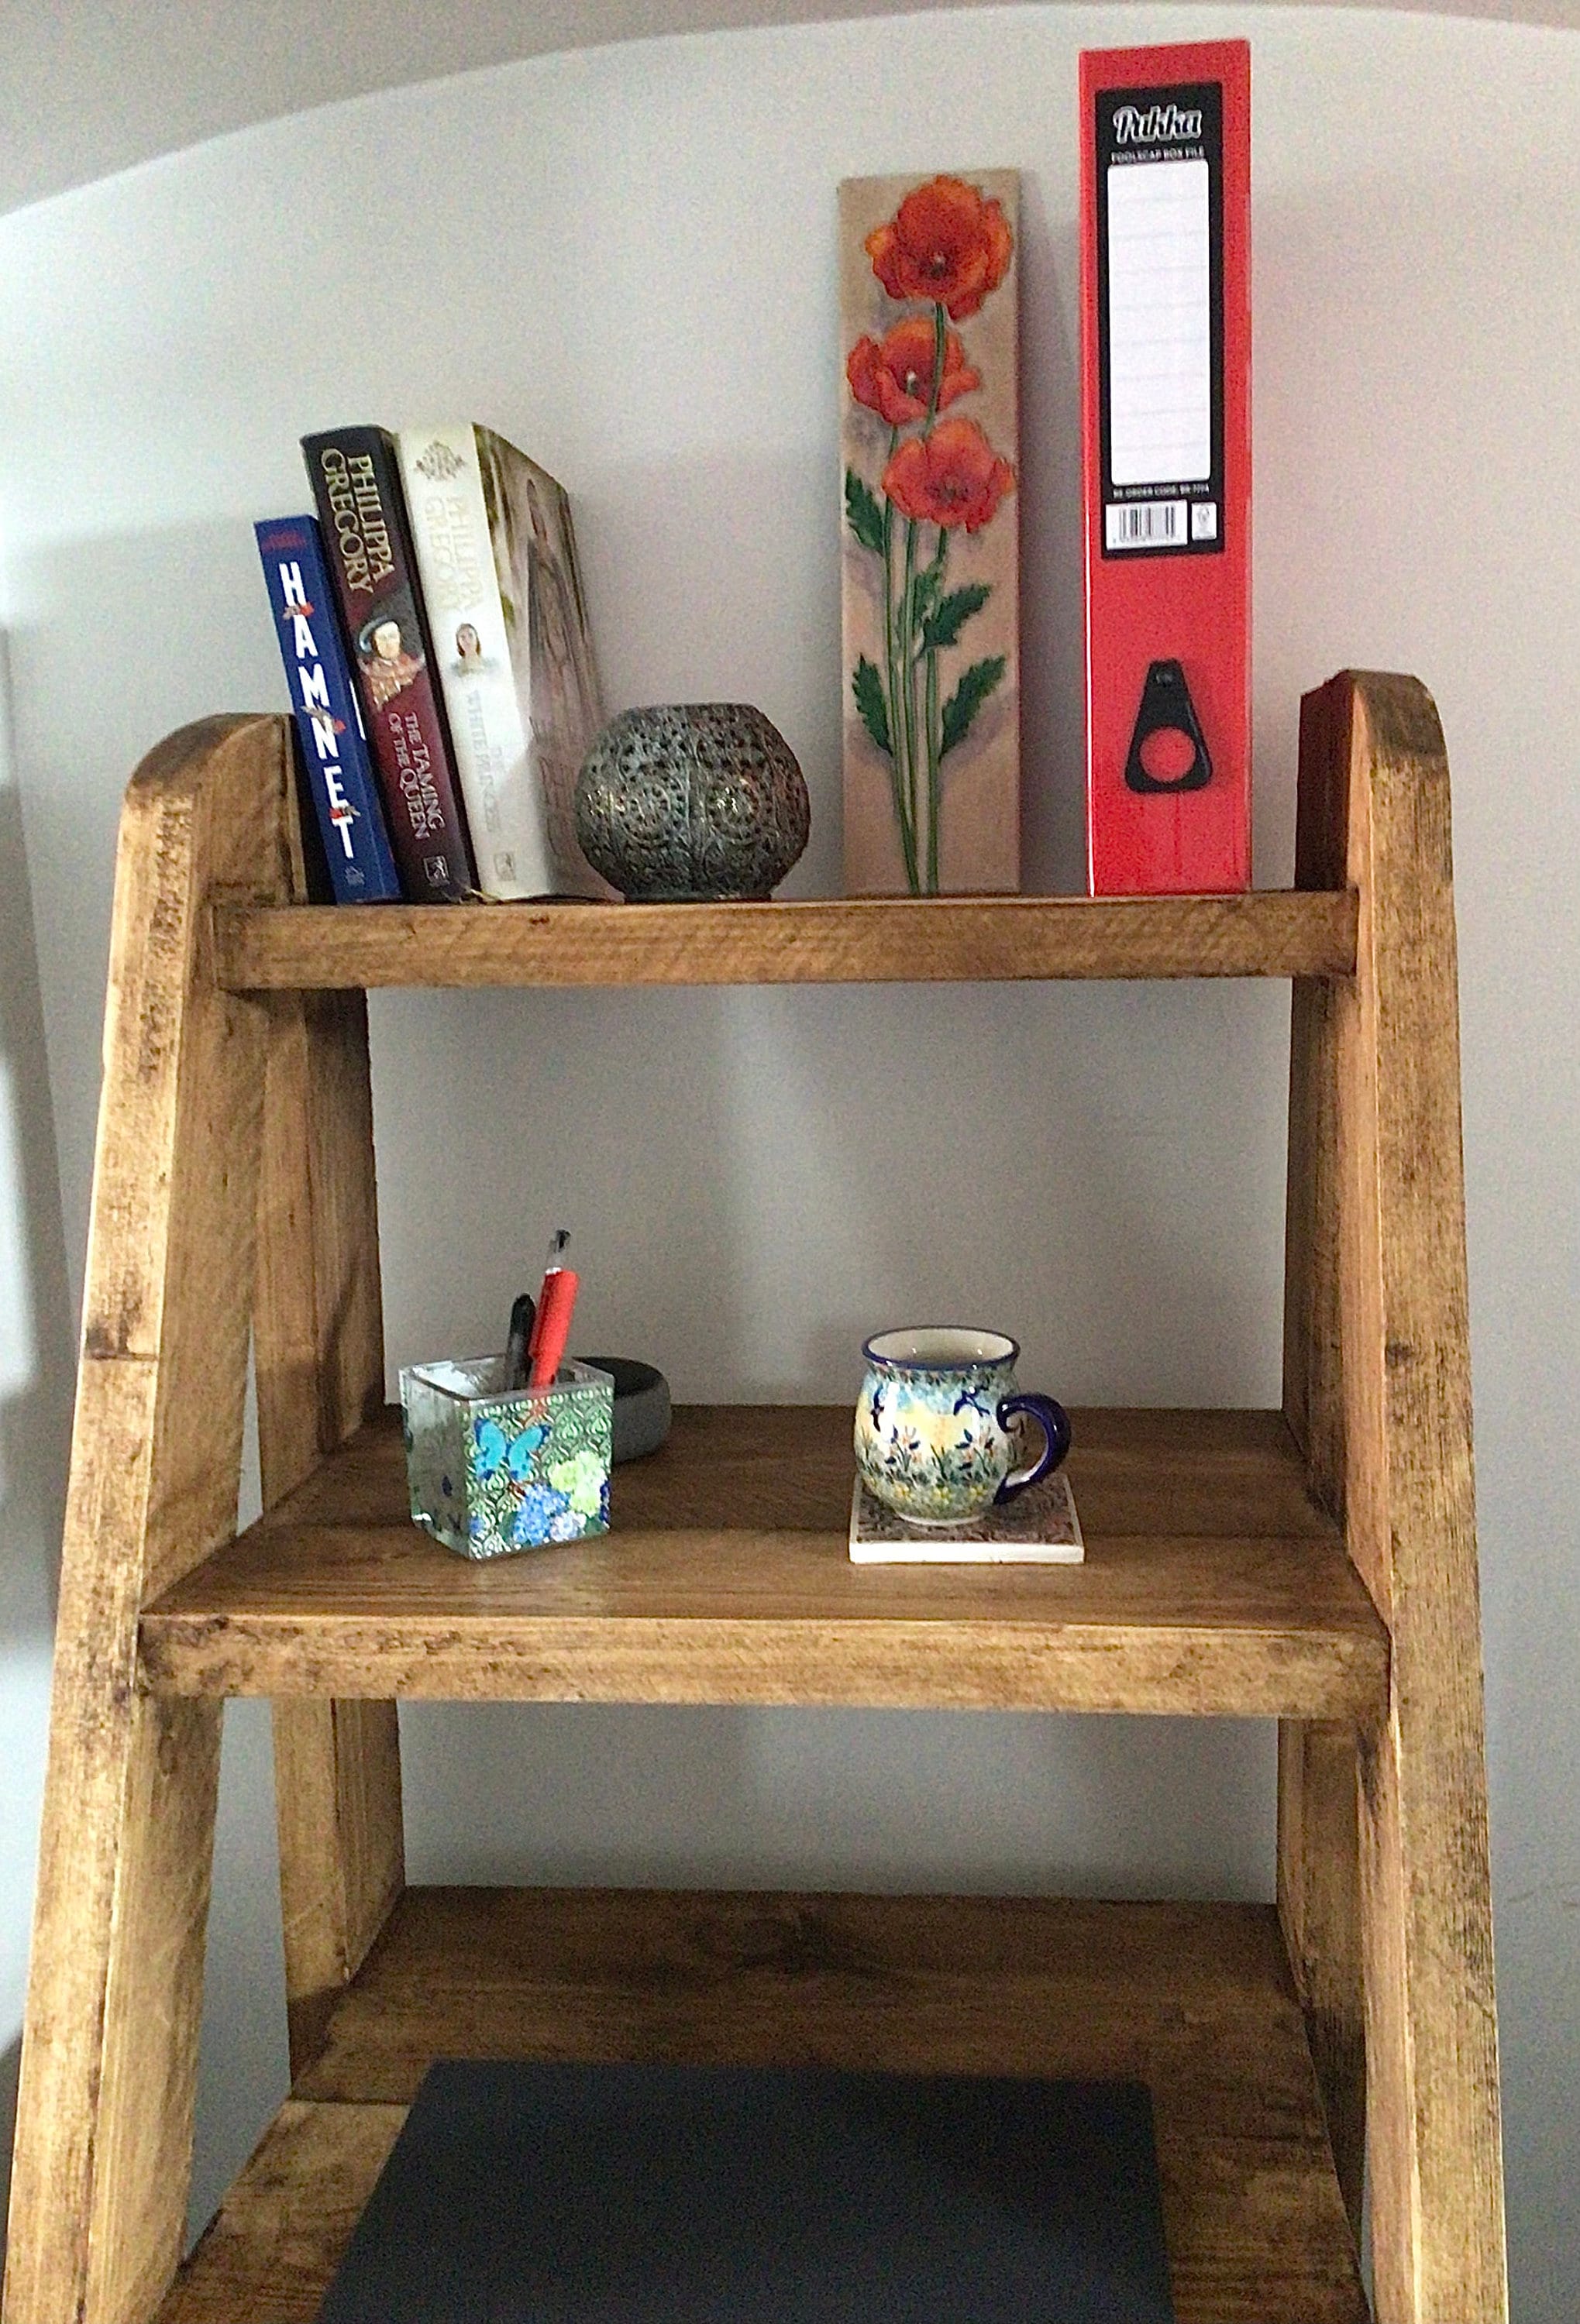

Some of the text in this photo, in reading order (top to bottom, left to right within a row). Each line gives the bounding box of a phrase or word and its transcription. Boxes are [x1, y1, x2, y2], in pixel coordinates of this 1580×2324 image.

[1112, 104, 1203, 145] Pukka
[320, 447, 375, 595] GREGORY
[346, 452, 396, 584] PHILIPPA
[279, 561, 355, 860] HAMNET
[404, 711, 447, 831] THE TAMING
[387, 712, 431, 841] OF THE QUEEN
